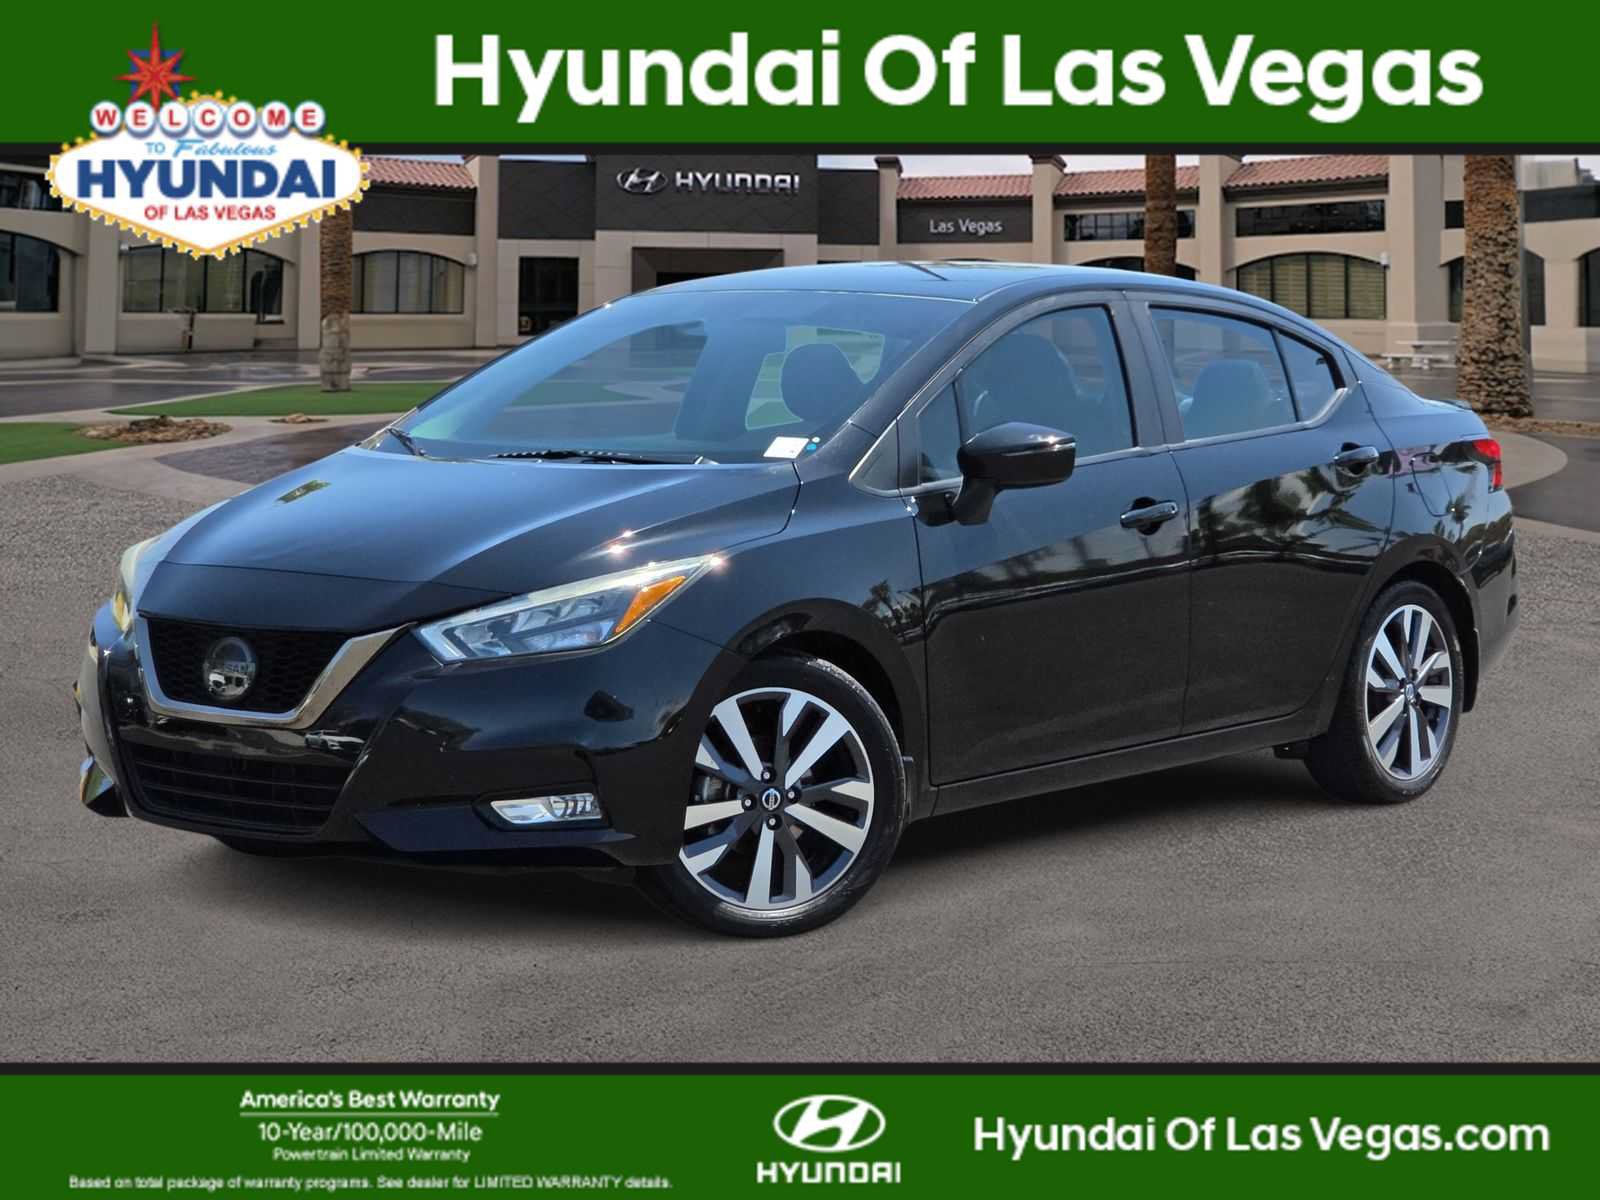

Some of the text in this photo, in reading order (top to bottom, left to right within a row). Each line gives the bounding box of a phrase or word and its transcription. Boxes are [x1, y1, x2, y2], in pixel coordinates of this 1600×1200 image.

[675, 171, 800, 190] HYUNDAI
[929, 218, 1003, 236] Las Vegas
